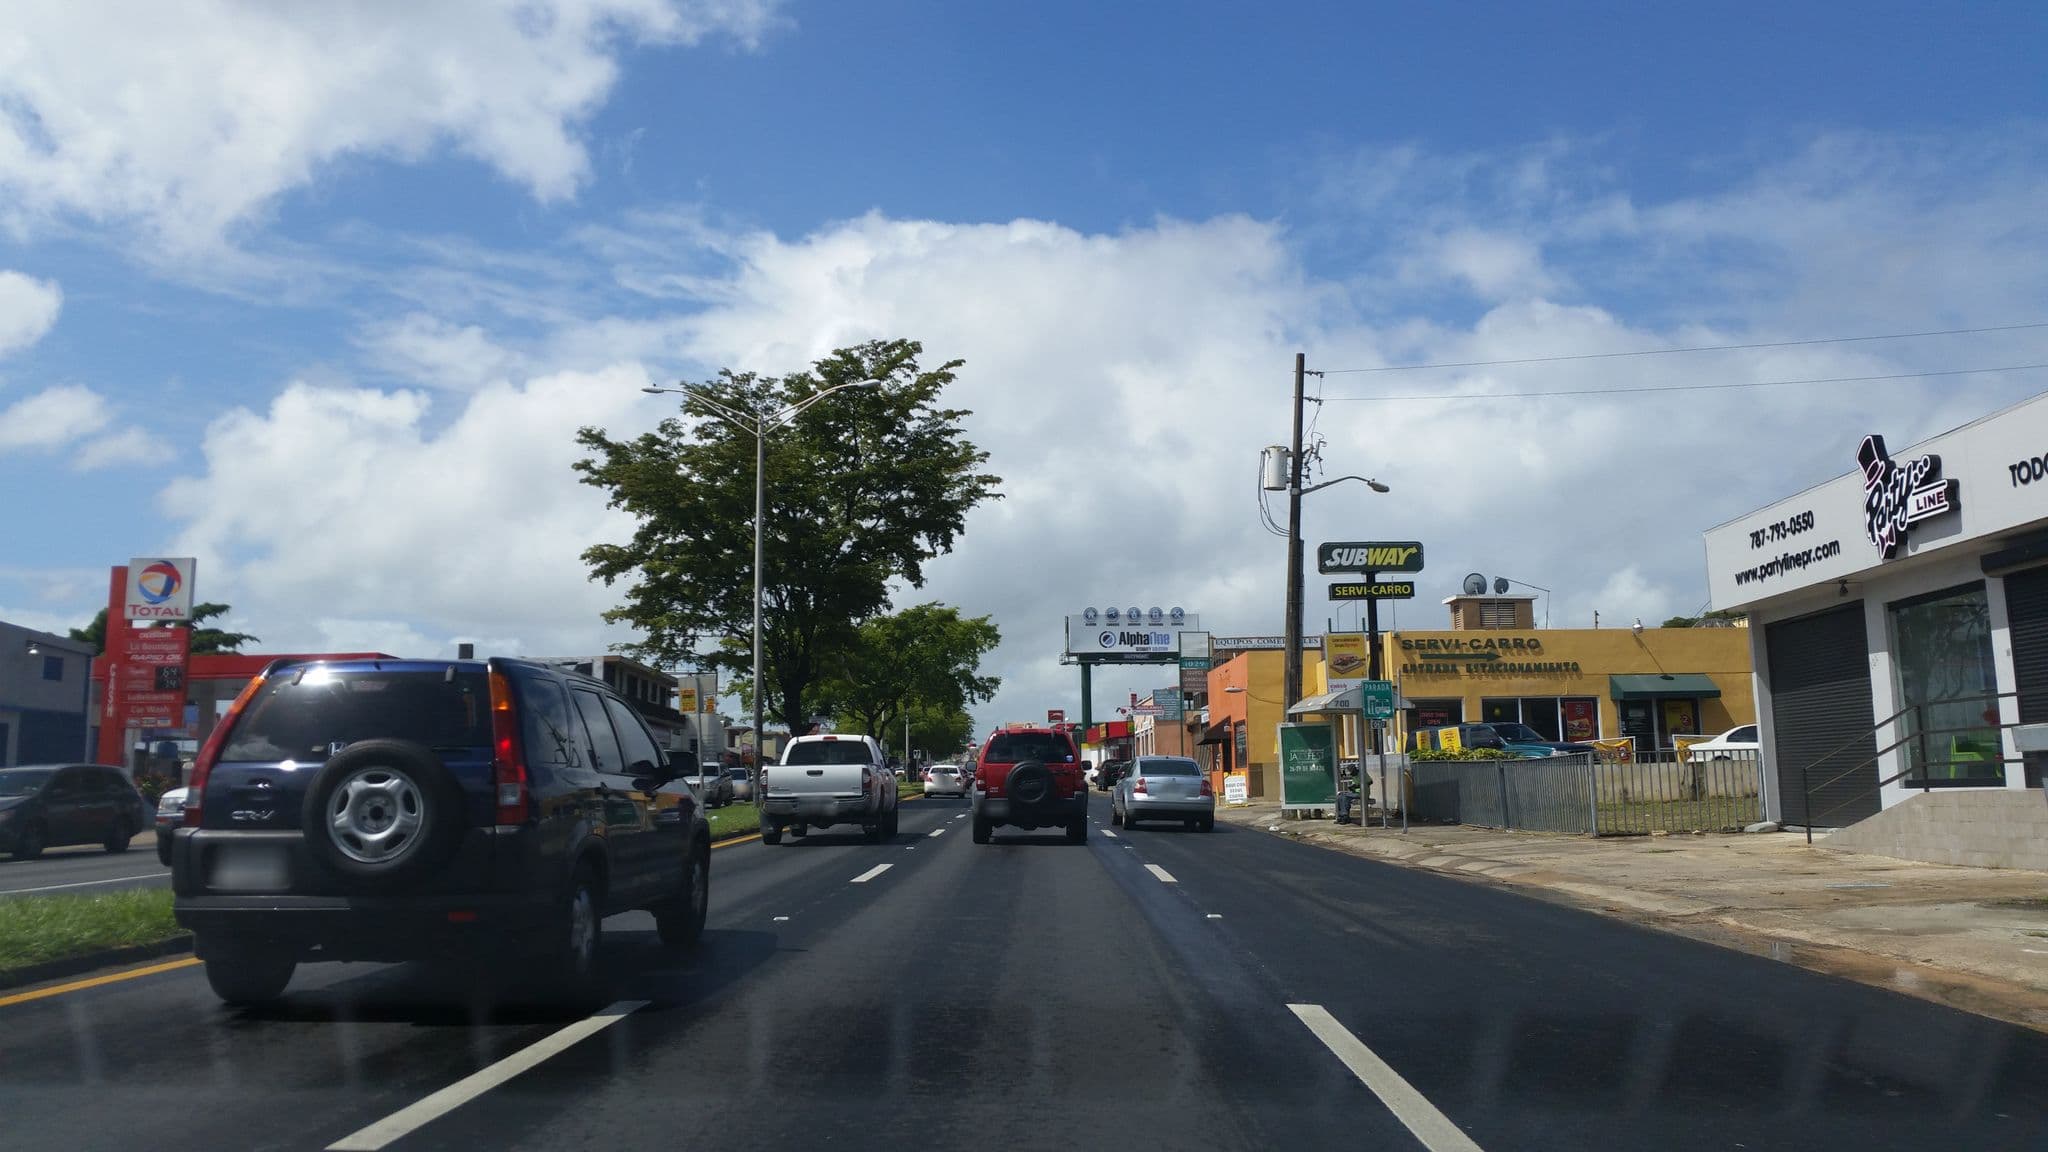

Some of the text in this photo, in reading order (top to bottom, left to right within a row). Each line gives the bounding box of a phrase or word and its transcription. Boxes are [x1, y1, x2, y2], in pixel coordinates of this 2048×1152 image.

[1866, 461, 1914, 545] Party
[1916, 491, 1945, 511] LINE
[1749, 510, 1815, 550] 787-793-0550
[1325, 546, 1418, 567] SUBWAY
[1735, 540, 1841, 586] www.partylinepr.com
[1335, 584, 1411, 596] SERVI-CARRO
[128, 604, 184, 617] TOTAL
[1215, 638, 1251, 646] EQUIPOS
[1401, 637, 1541, 650] SERVI-CARRO
[1402, 661, 1579, 674] ENTRADA ESTACIONAMIENTO
[1364, 684, 1390, 692] PARADA
